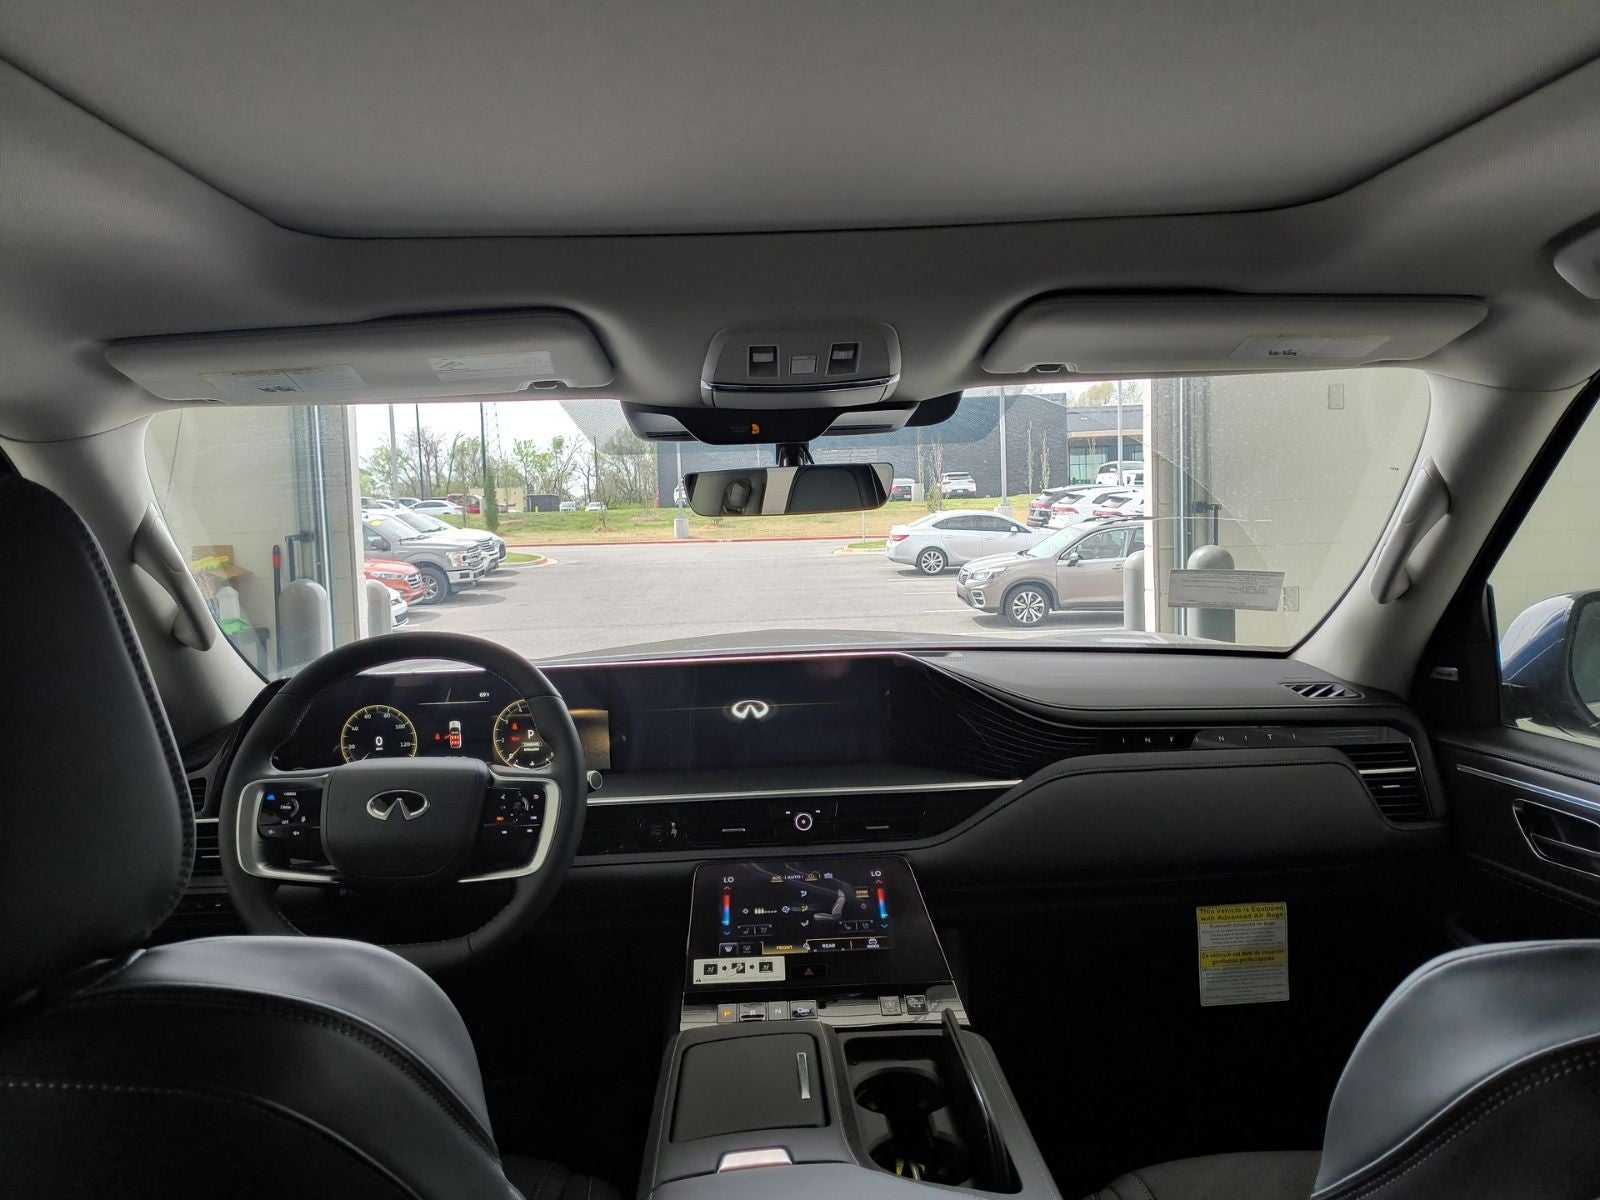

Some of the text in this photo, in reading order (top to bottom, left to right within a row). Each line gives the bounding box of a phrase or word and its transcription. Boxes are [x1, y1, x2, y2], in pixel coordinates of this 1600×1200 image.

[527, 729, 535, 739] P
[1122, 733, 1296, 744] INFINITI
[375, 735, 383, 746] 0
